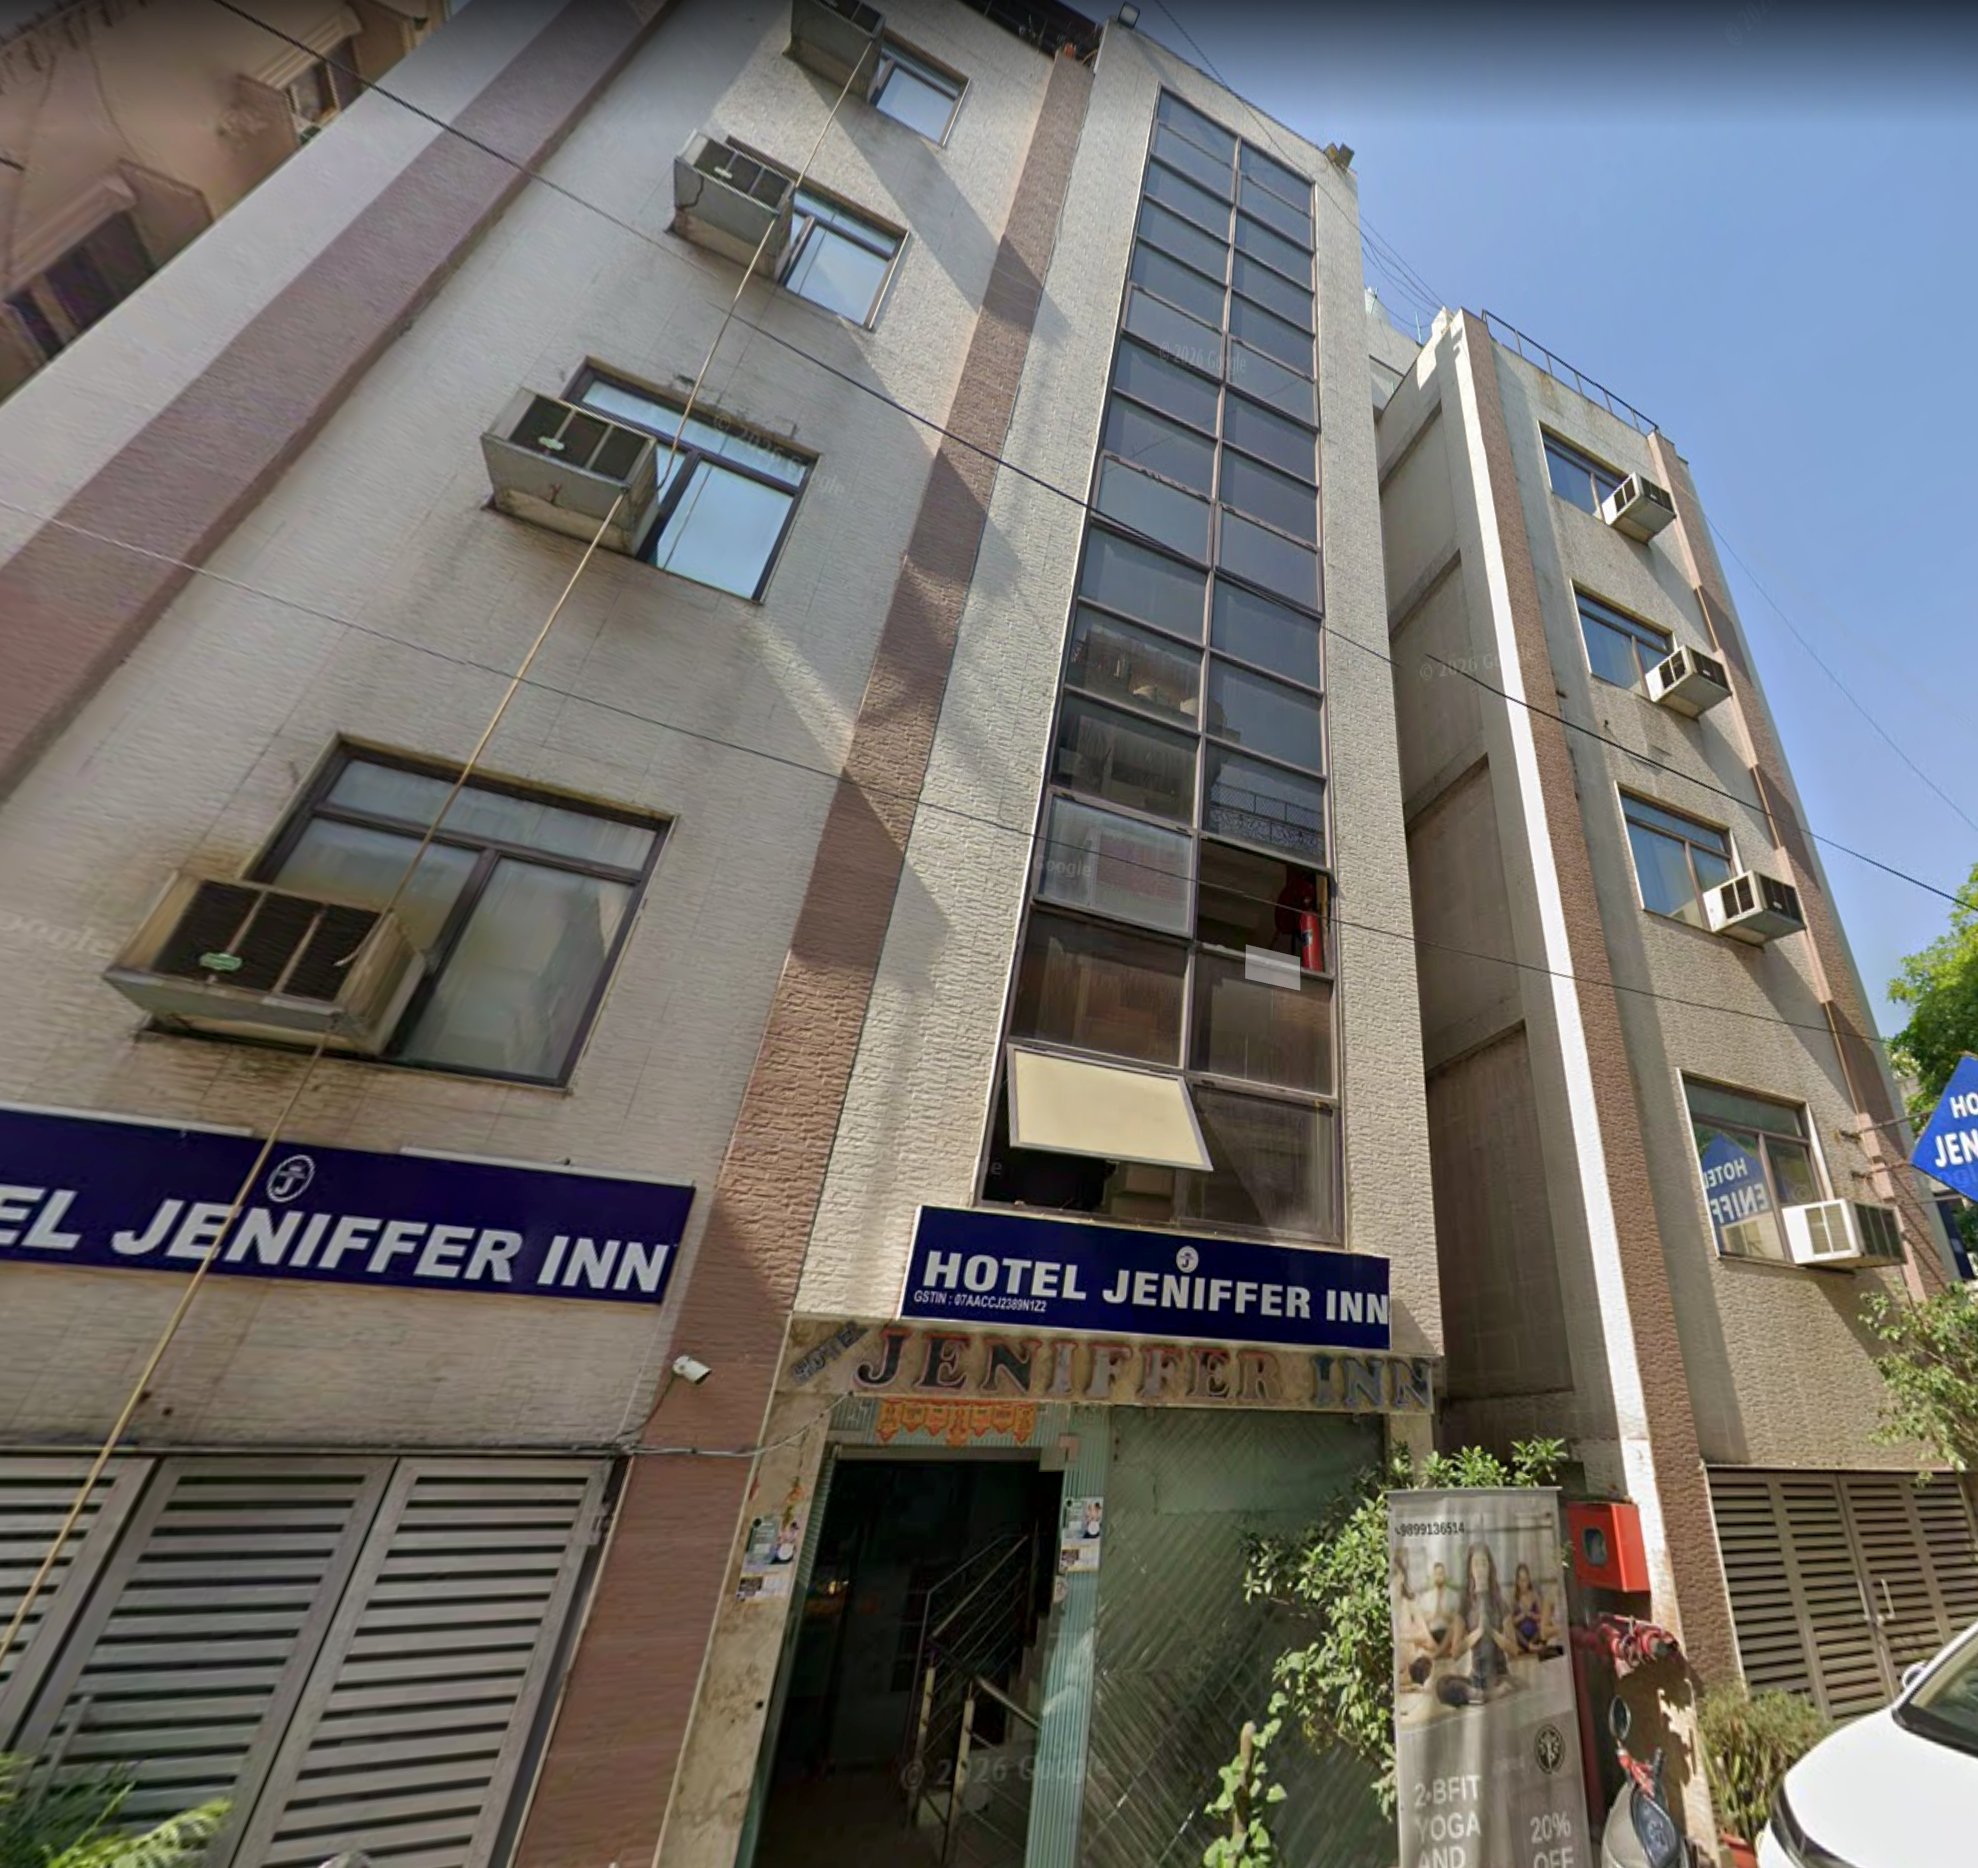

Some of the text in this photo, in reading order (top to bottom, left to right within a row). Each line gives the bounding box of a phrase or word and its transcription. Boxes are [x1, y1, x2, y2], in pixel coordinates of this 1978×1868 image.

[1949, 1092, 1978, 1119] HO
[1934, 1128, 1978, 1168] JEN
[0, 1184, 670, 1293] EL JENIFFER INN
[914, 1290, 947, 1305] GSTIN
[922, 1250, 1389, 1325] HOTEL JENIFFER INN
[854, 1326, 1434, 1408] JENIFFER INN
[1414, 1809, 1480, 1842] YOGA
[1530, 1811, 1573, 1844] 20%
[1416, 1844, 1466, 1868] AND
